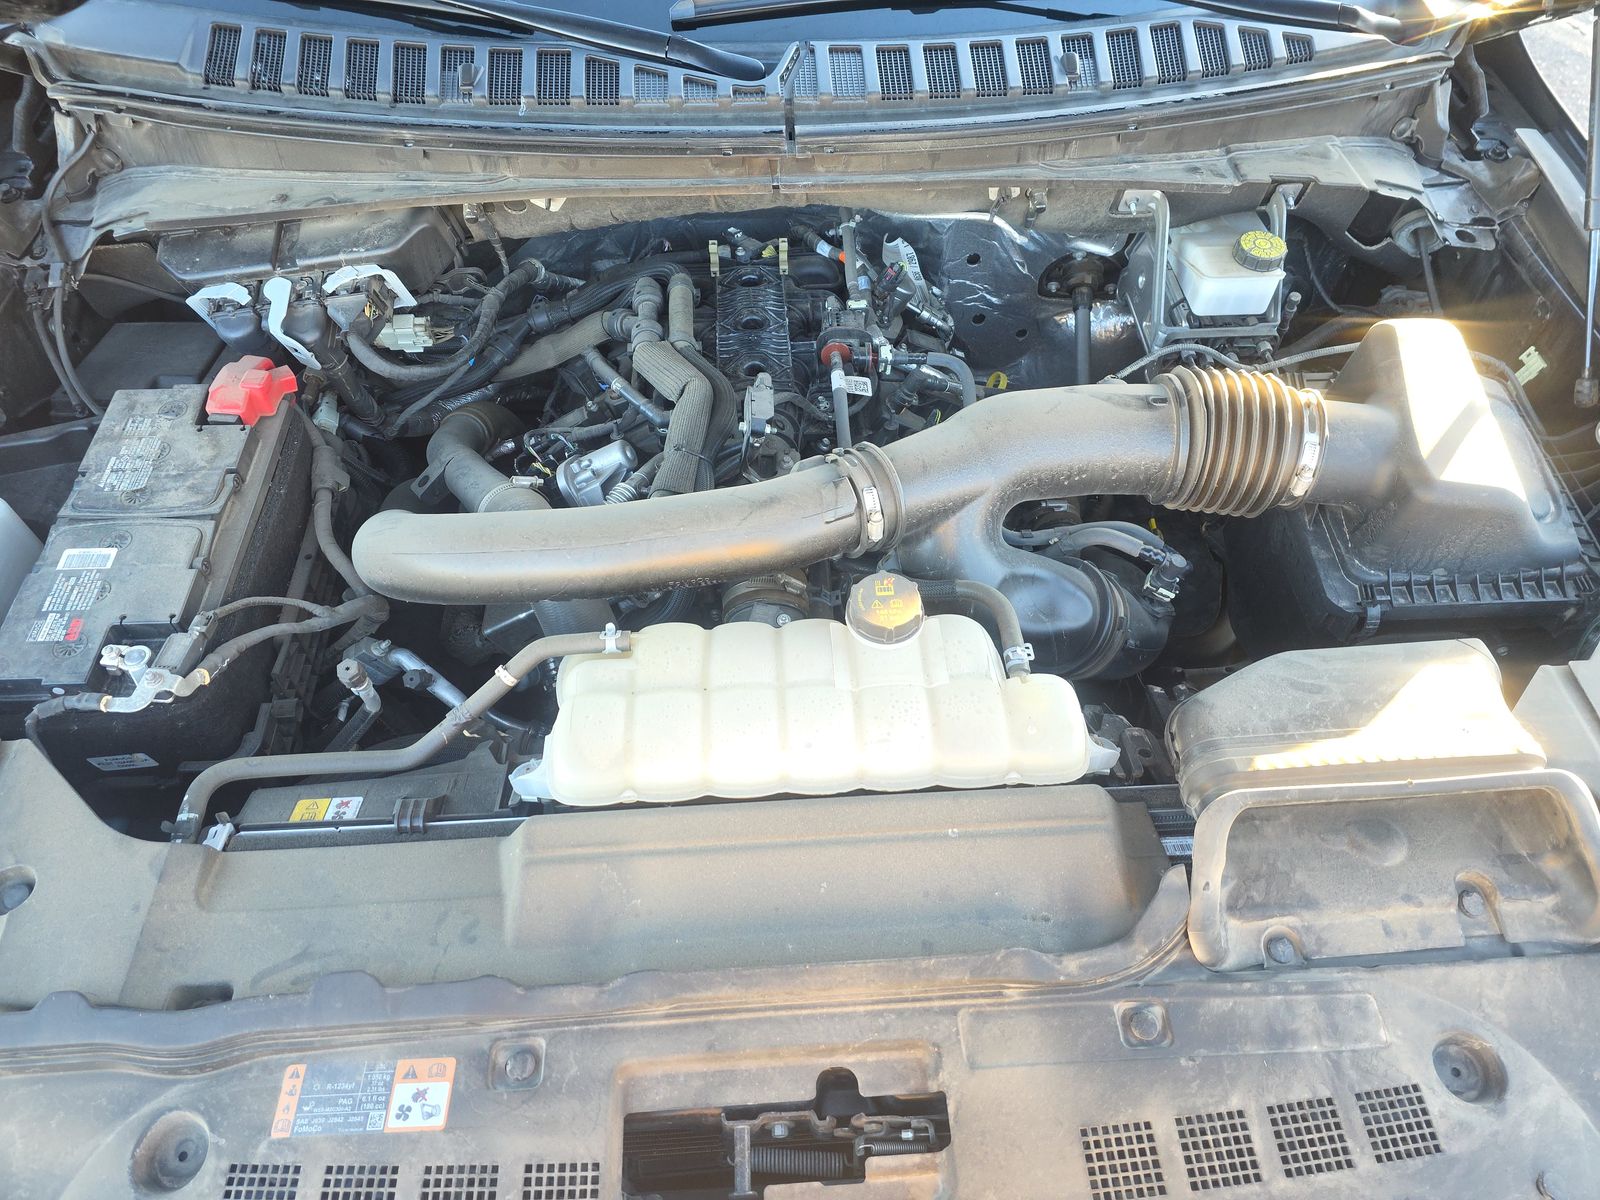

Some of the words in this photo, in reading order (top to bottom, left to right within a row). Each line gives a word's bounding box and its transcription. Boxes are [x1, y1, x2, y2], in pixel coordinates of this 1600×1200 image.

[326, 1081, 356, 1090] R-1234yf
[338, 1097, 353, 1105] PAG
[293, 1124, 322, 1133] FoMoCo
